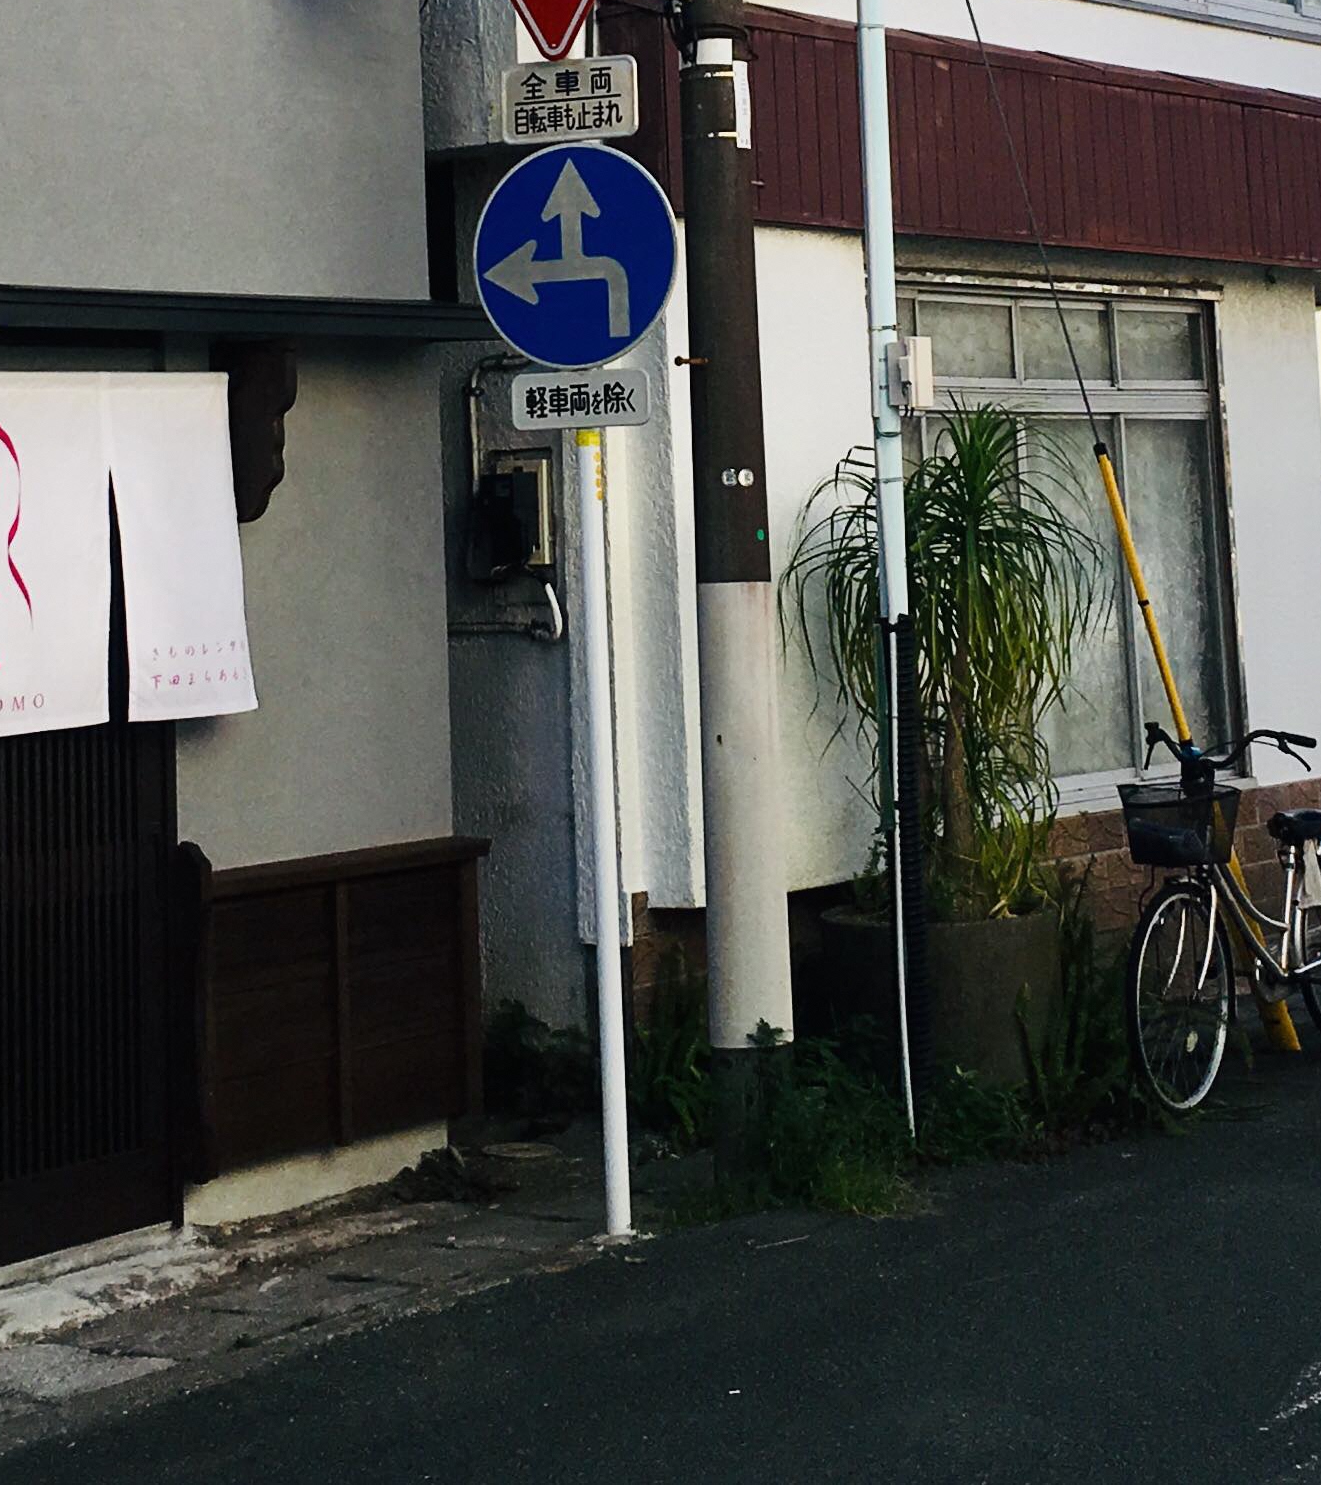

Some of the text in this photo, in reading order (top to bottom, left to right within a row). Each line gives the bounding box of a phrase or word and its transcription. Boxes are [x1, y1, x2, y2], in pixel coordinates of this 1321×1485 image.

[520, 66, 613, 101] 全車両
[514, 100, 623, 135] 自転車も止まれ
[525, 381, 636, 419] 軽車両を除く
